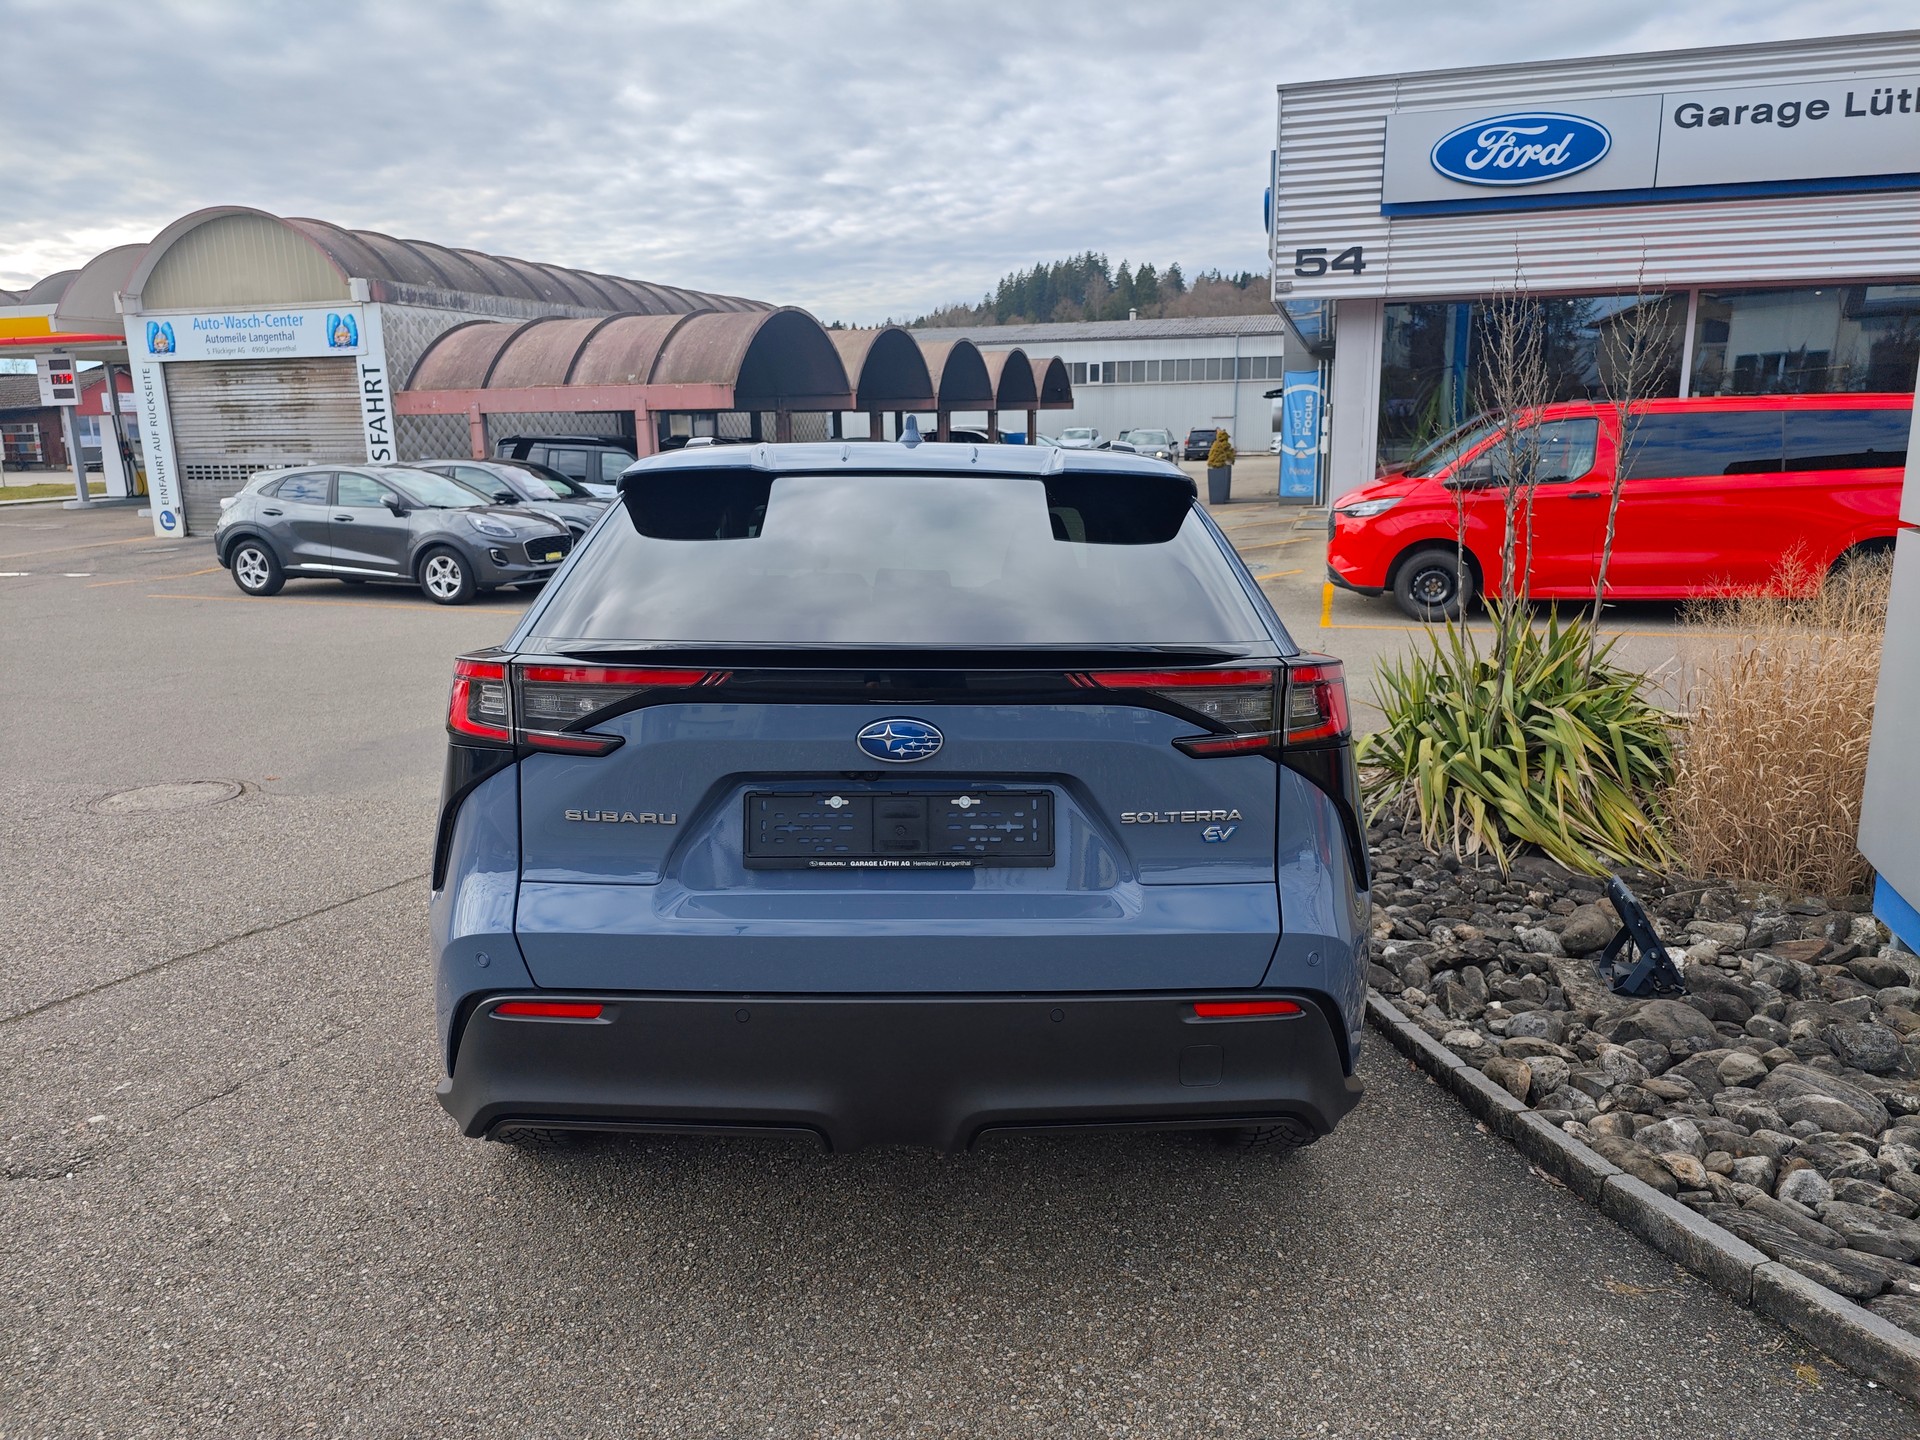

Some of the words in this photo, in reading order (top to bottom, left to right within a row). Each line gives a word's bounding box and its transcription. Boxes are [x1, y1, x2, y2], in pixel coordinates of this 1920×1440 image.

[1674, 99, 1830, 128] Garage
[1465, 124, 1576, 171] Ford
[1294, 246, 1367, 277] 54
[193, 313, 304, 331] Auto-Wasch-Center
[205, 332, 247, 344] Automeile
[249, 331, 295, 345] Langenthal
[237, 346, 246, 354] AG
[266, 344, 297, 354] Langenthal
[1292, 410, 1302, 436] Ford
[1302, 395, 1314, 436] Focus
[153, 430, 161, 452] AUF
[155, 454, 170, 506] EINFAHRT
[1288, 467, 1312, 476] New
[564, 809, 677, 825] SUBARU
[1120, 809, 1243, 824] SOLTERRA
[1202, 824, 1238, 842] EV
[879, 859, 899, 867] LÜTHI
[942, 860, 971, 868] Langenthal
